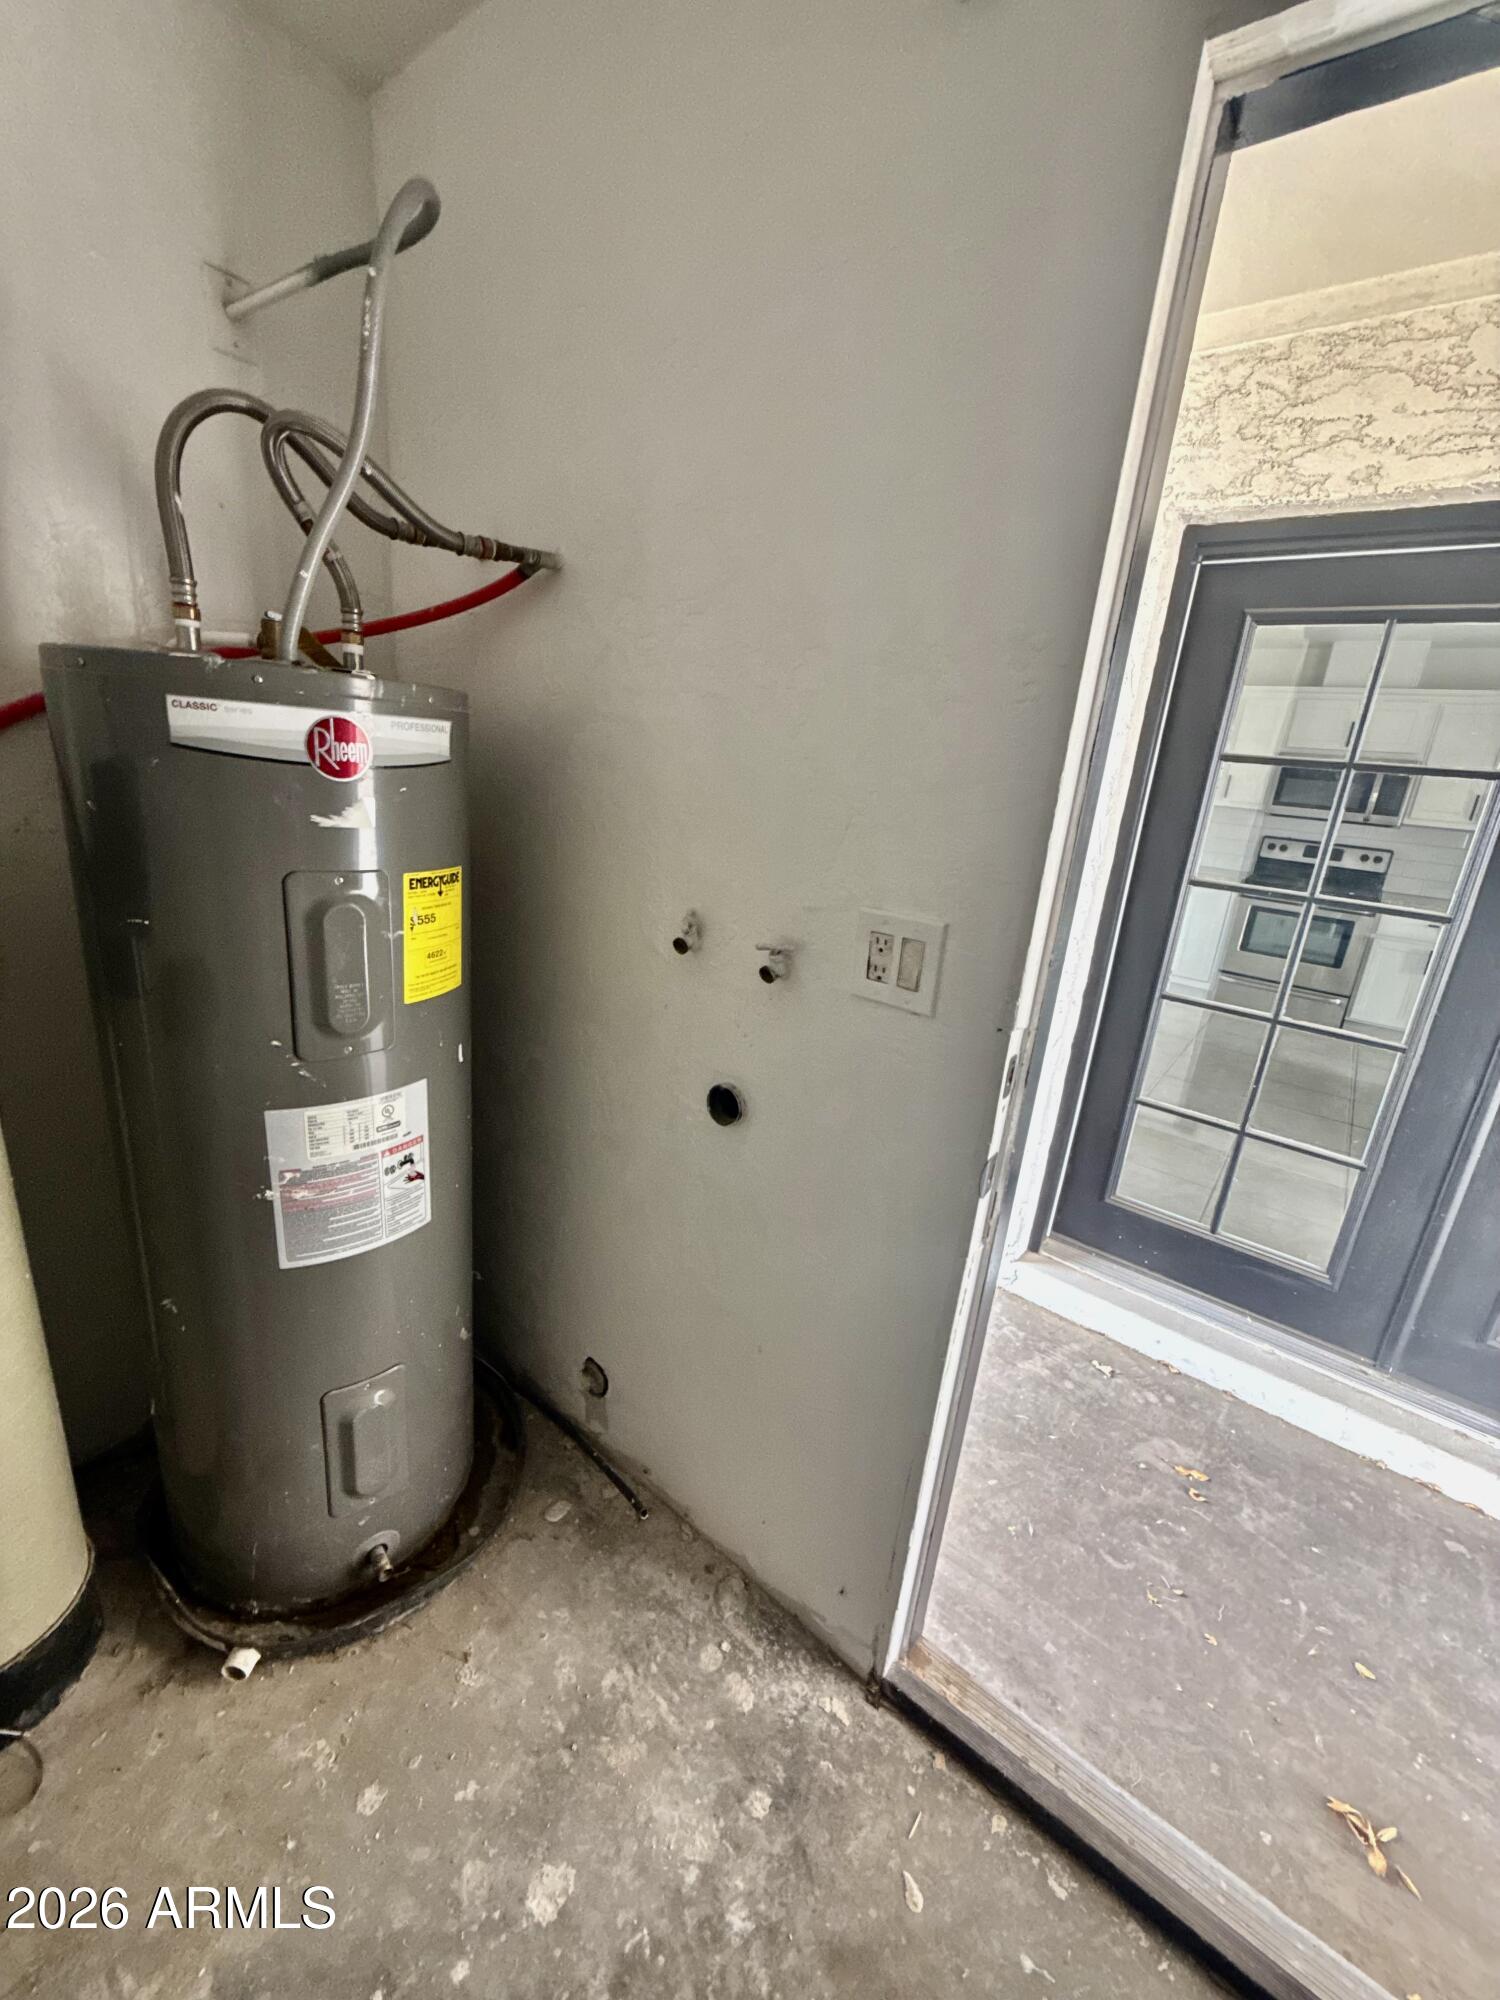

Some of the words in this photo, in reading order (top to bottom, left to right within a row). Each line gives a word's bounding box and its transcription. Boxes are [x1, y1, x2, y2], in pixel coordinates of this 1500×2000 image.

[171, 699, 218, 712] CLASSIC
[390, 720, 449, 734] PROFESSIONAL
[313, 718, 369, 770] Rheem
[392, 1136, 423, 1154] DANGER
